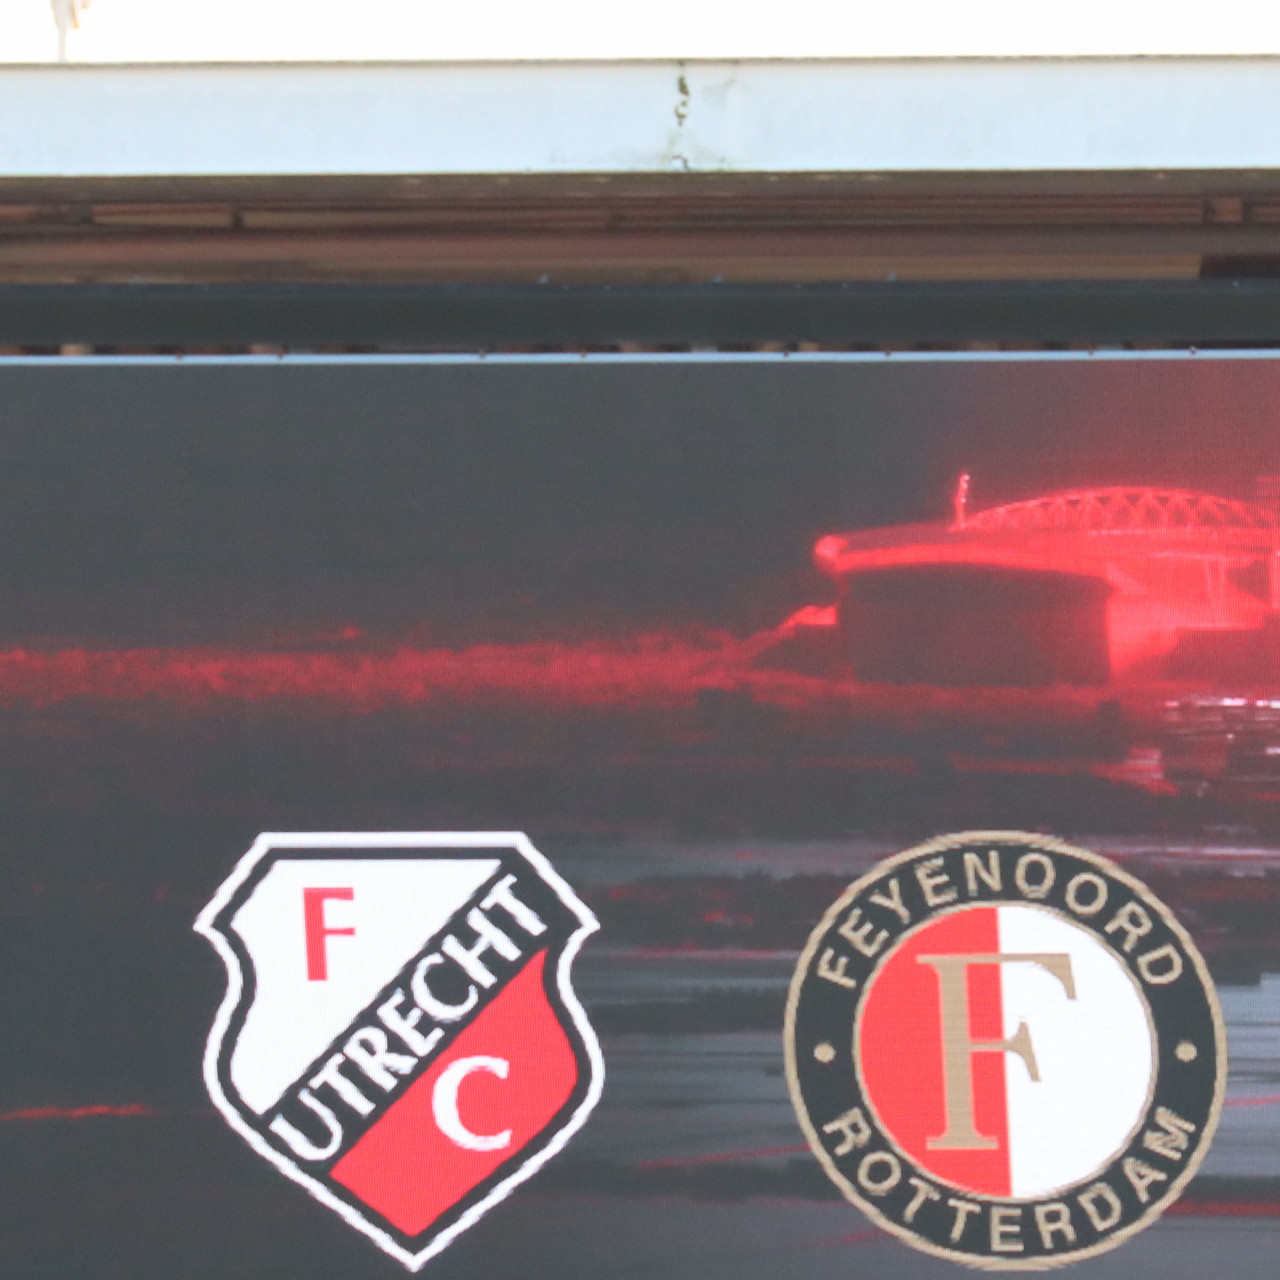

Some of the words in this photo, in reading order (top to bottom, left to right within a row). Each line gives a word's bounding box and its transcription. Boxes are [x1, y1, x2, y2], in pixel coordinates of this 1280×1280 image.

[303, 886, 356, 982] F
[816, 850, 1184, 989] FEYENOORD
[268, 873, 549, 1162] UTRECHT
[916, 952, 1077, 1151] F
[431, 1055, 513, 1152] C
[822, 1105, 1197, 1253] ROTTERDAM
